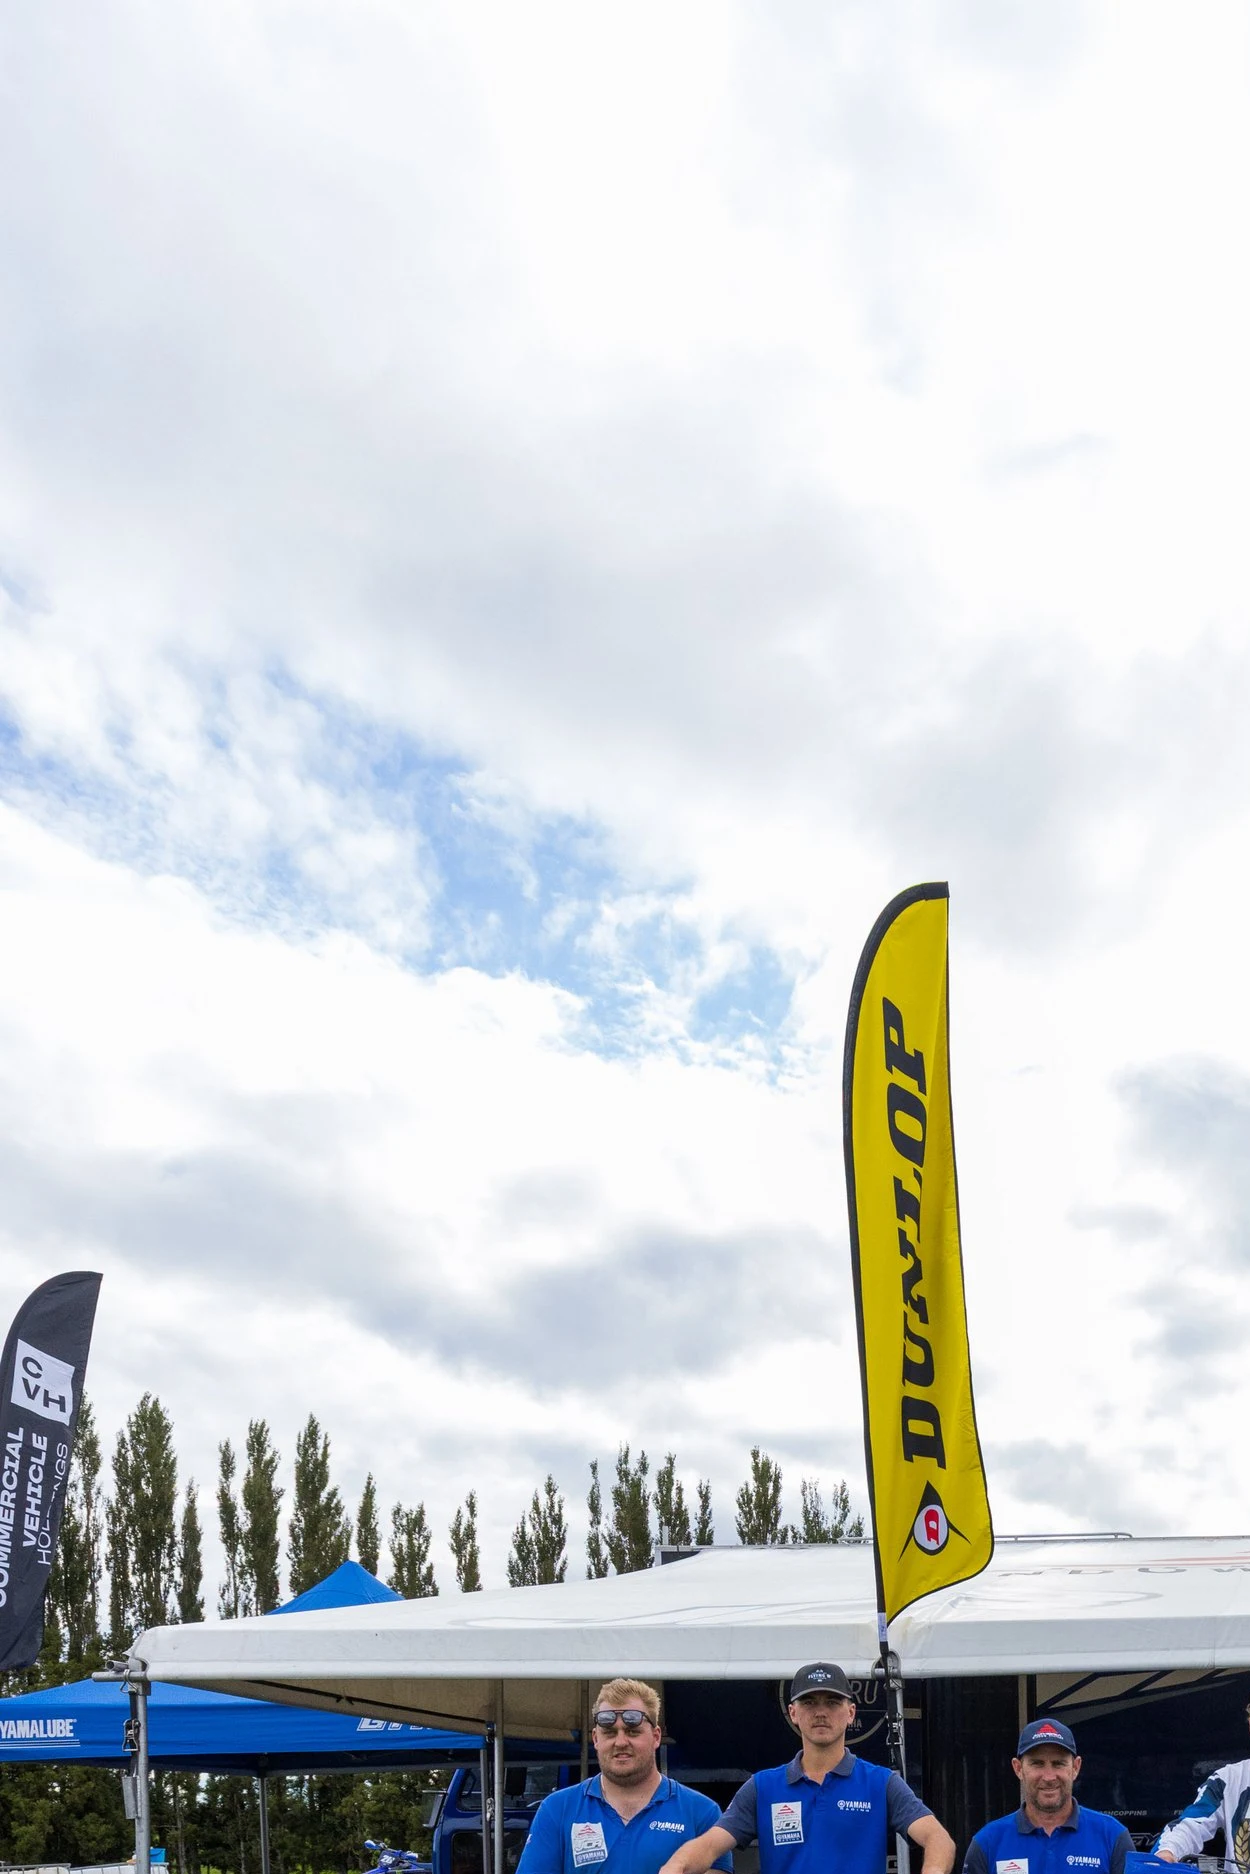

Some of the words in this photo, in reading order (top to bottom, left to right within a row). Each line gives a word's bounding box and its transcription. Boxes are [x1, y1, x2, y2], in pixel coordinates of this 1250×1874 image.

[882, 996, 947, 1471] DUNLOP
[23, 1436, 48, 1548] VEHICLE
[0, 1719, 75, 1739] YAMALUBE
[845, 1800, 872, 1810] YAMAHA
[657, 1820, 685, 1832] YAMAHA
[1075, 1856, 1101, 1865] YAMAHA
